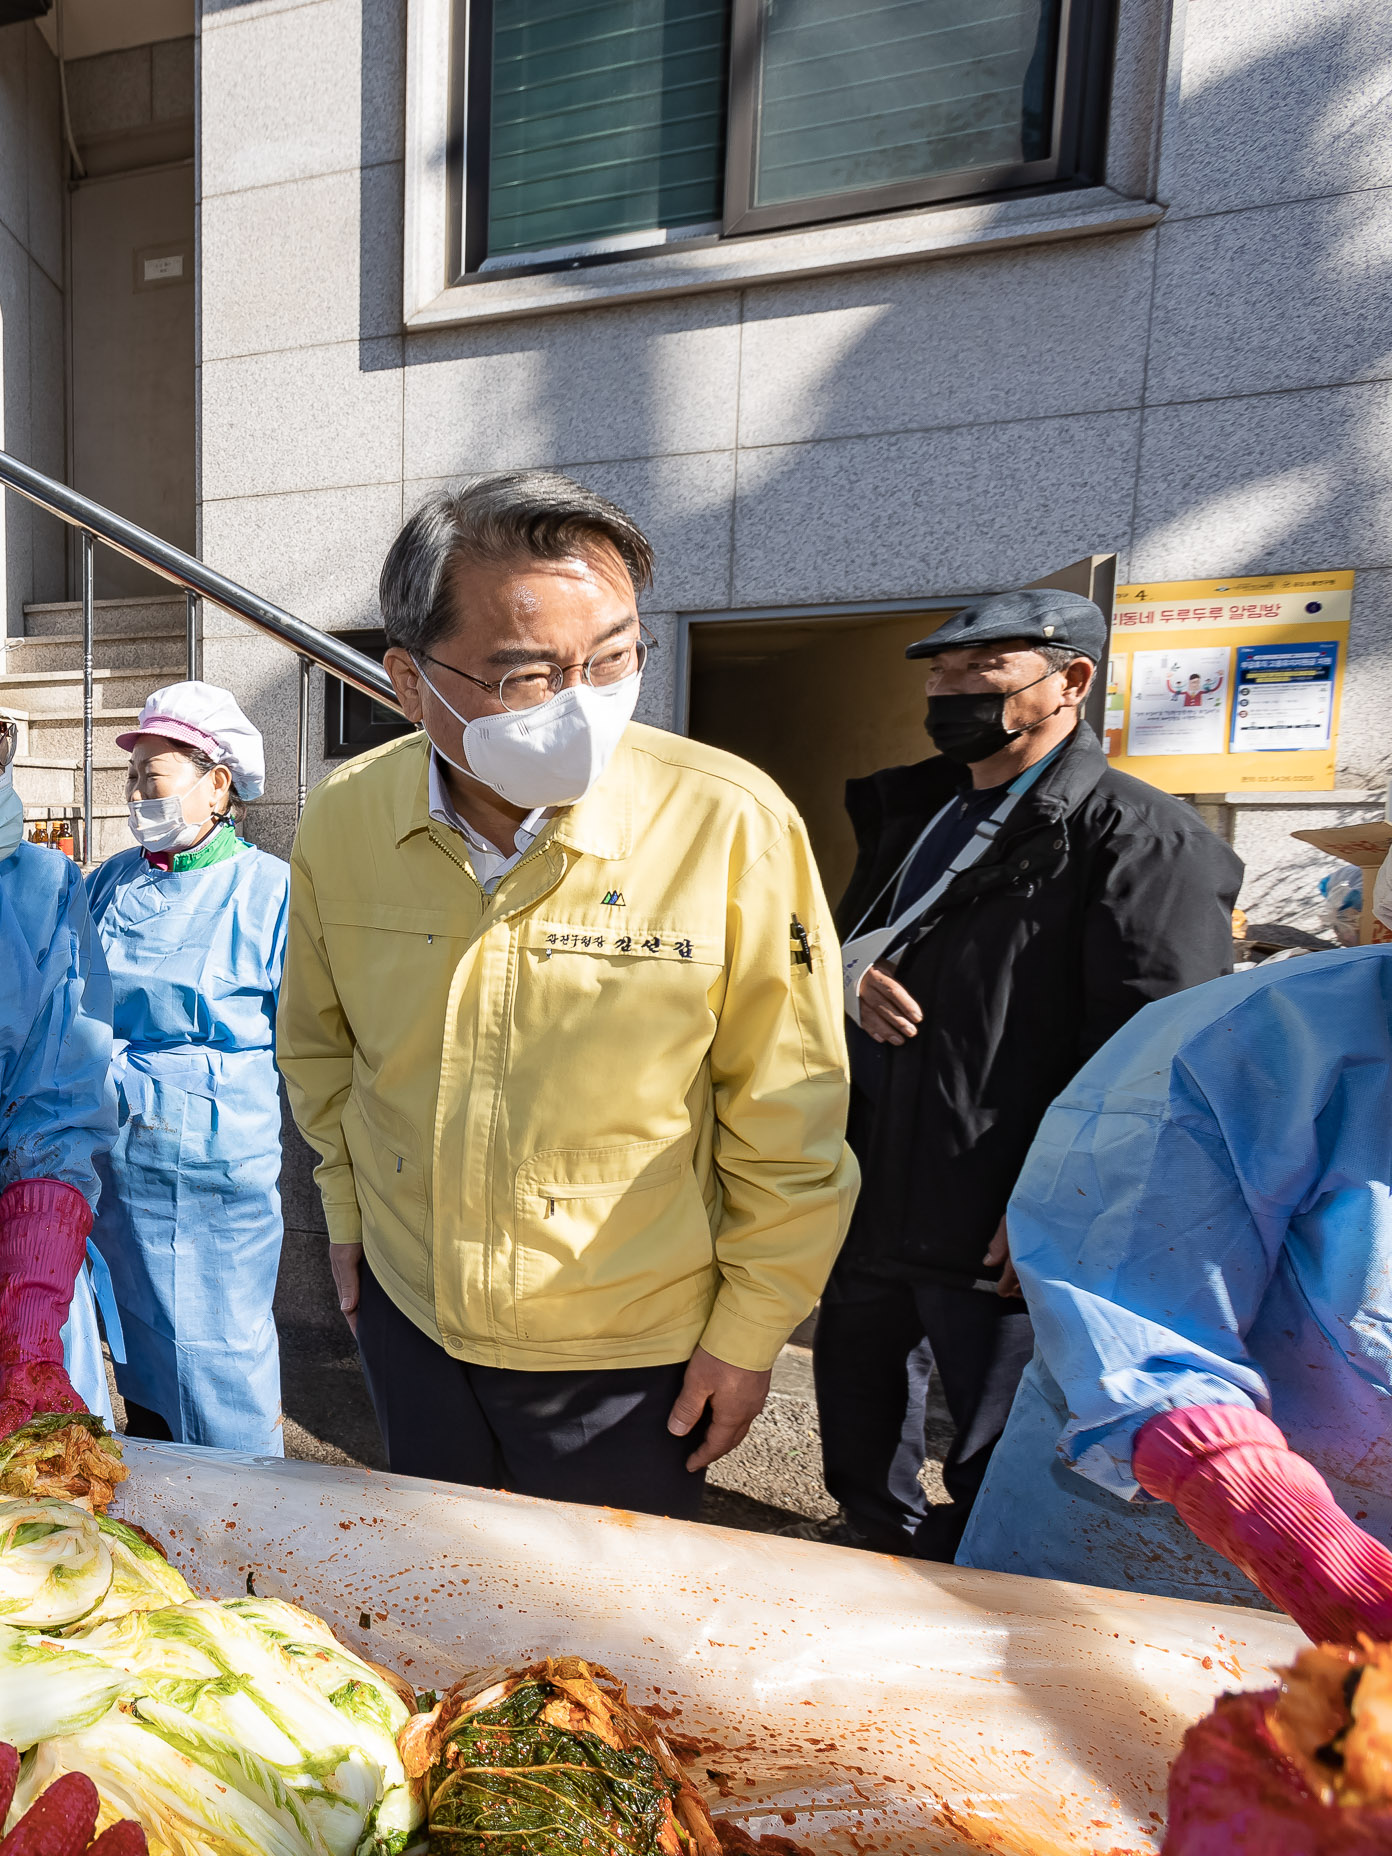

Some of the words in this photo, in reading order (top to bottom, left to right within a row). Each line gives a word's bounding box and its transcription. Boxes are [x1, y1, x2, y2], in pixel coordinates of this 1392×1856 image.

[1159, 606, 1224, 624] 두루두루
[1228, 603, 1283, 621] 알림방
[545, 933, 606, 949] 광진구청장
